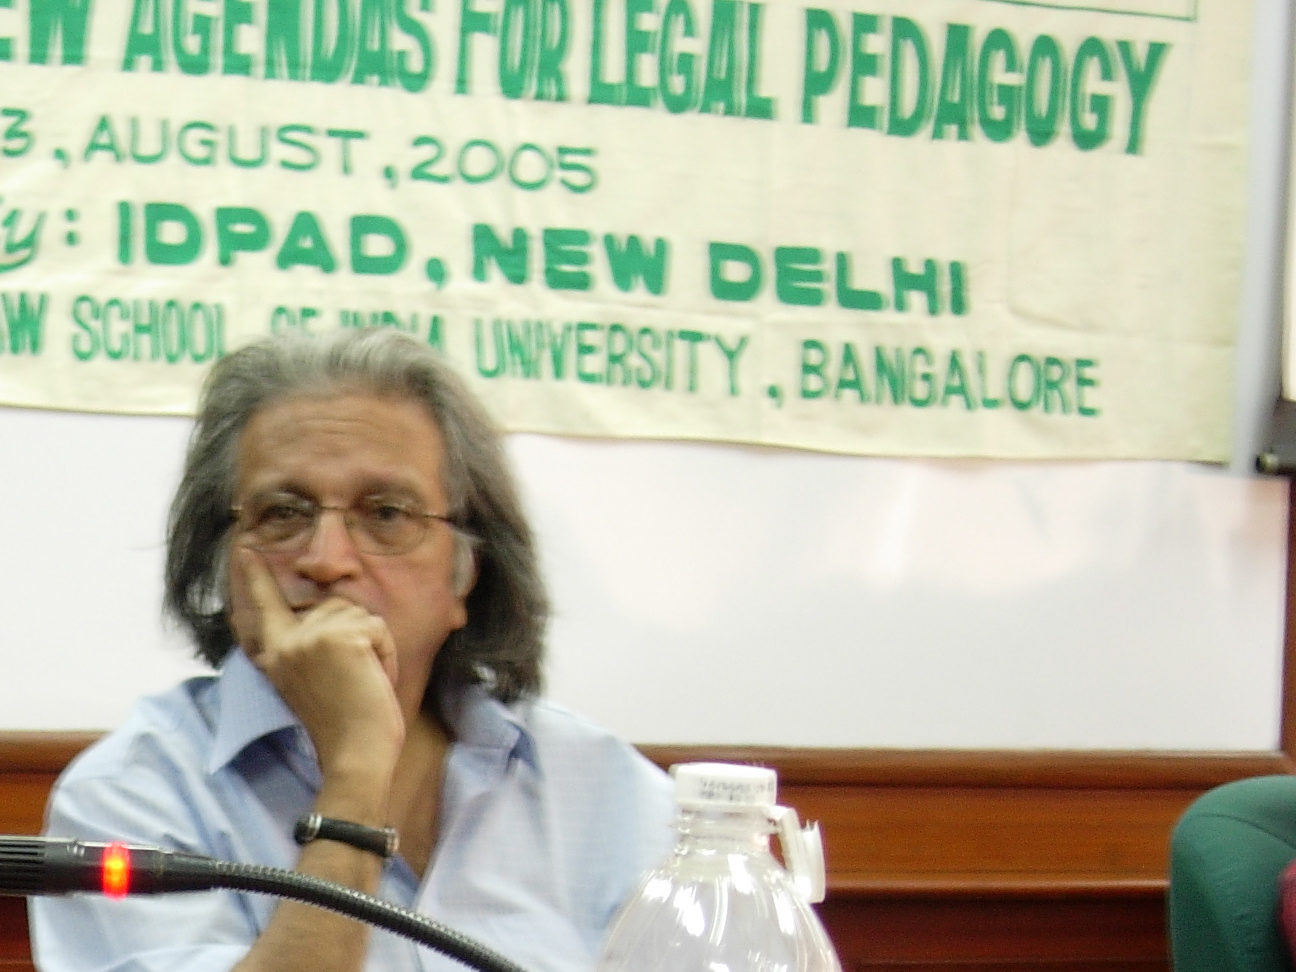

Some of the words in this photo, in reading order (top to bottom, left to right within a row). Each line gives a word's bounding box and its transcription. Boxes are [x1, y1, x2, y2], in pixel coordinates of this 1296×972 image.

[118, 0, 437, 94] AGENDAS
[452, 0, 572, 103] FOR
[586, 0, 777, 121] LEGAL
[800, 6, 1172, 156] PEDAGOGY
[409, 134, 598, 194] 2005
[115, 199, 449, 291] IDPAD,
[470, 221, 671, 298] NEW
[707, 240, 969, 317] DELHI
[70, 294, 230, 365] SCHOOL
[798, 337, 1101, 418] BANGALORE
